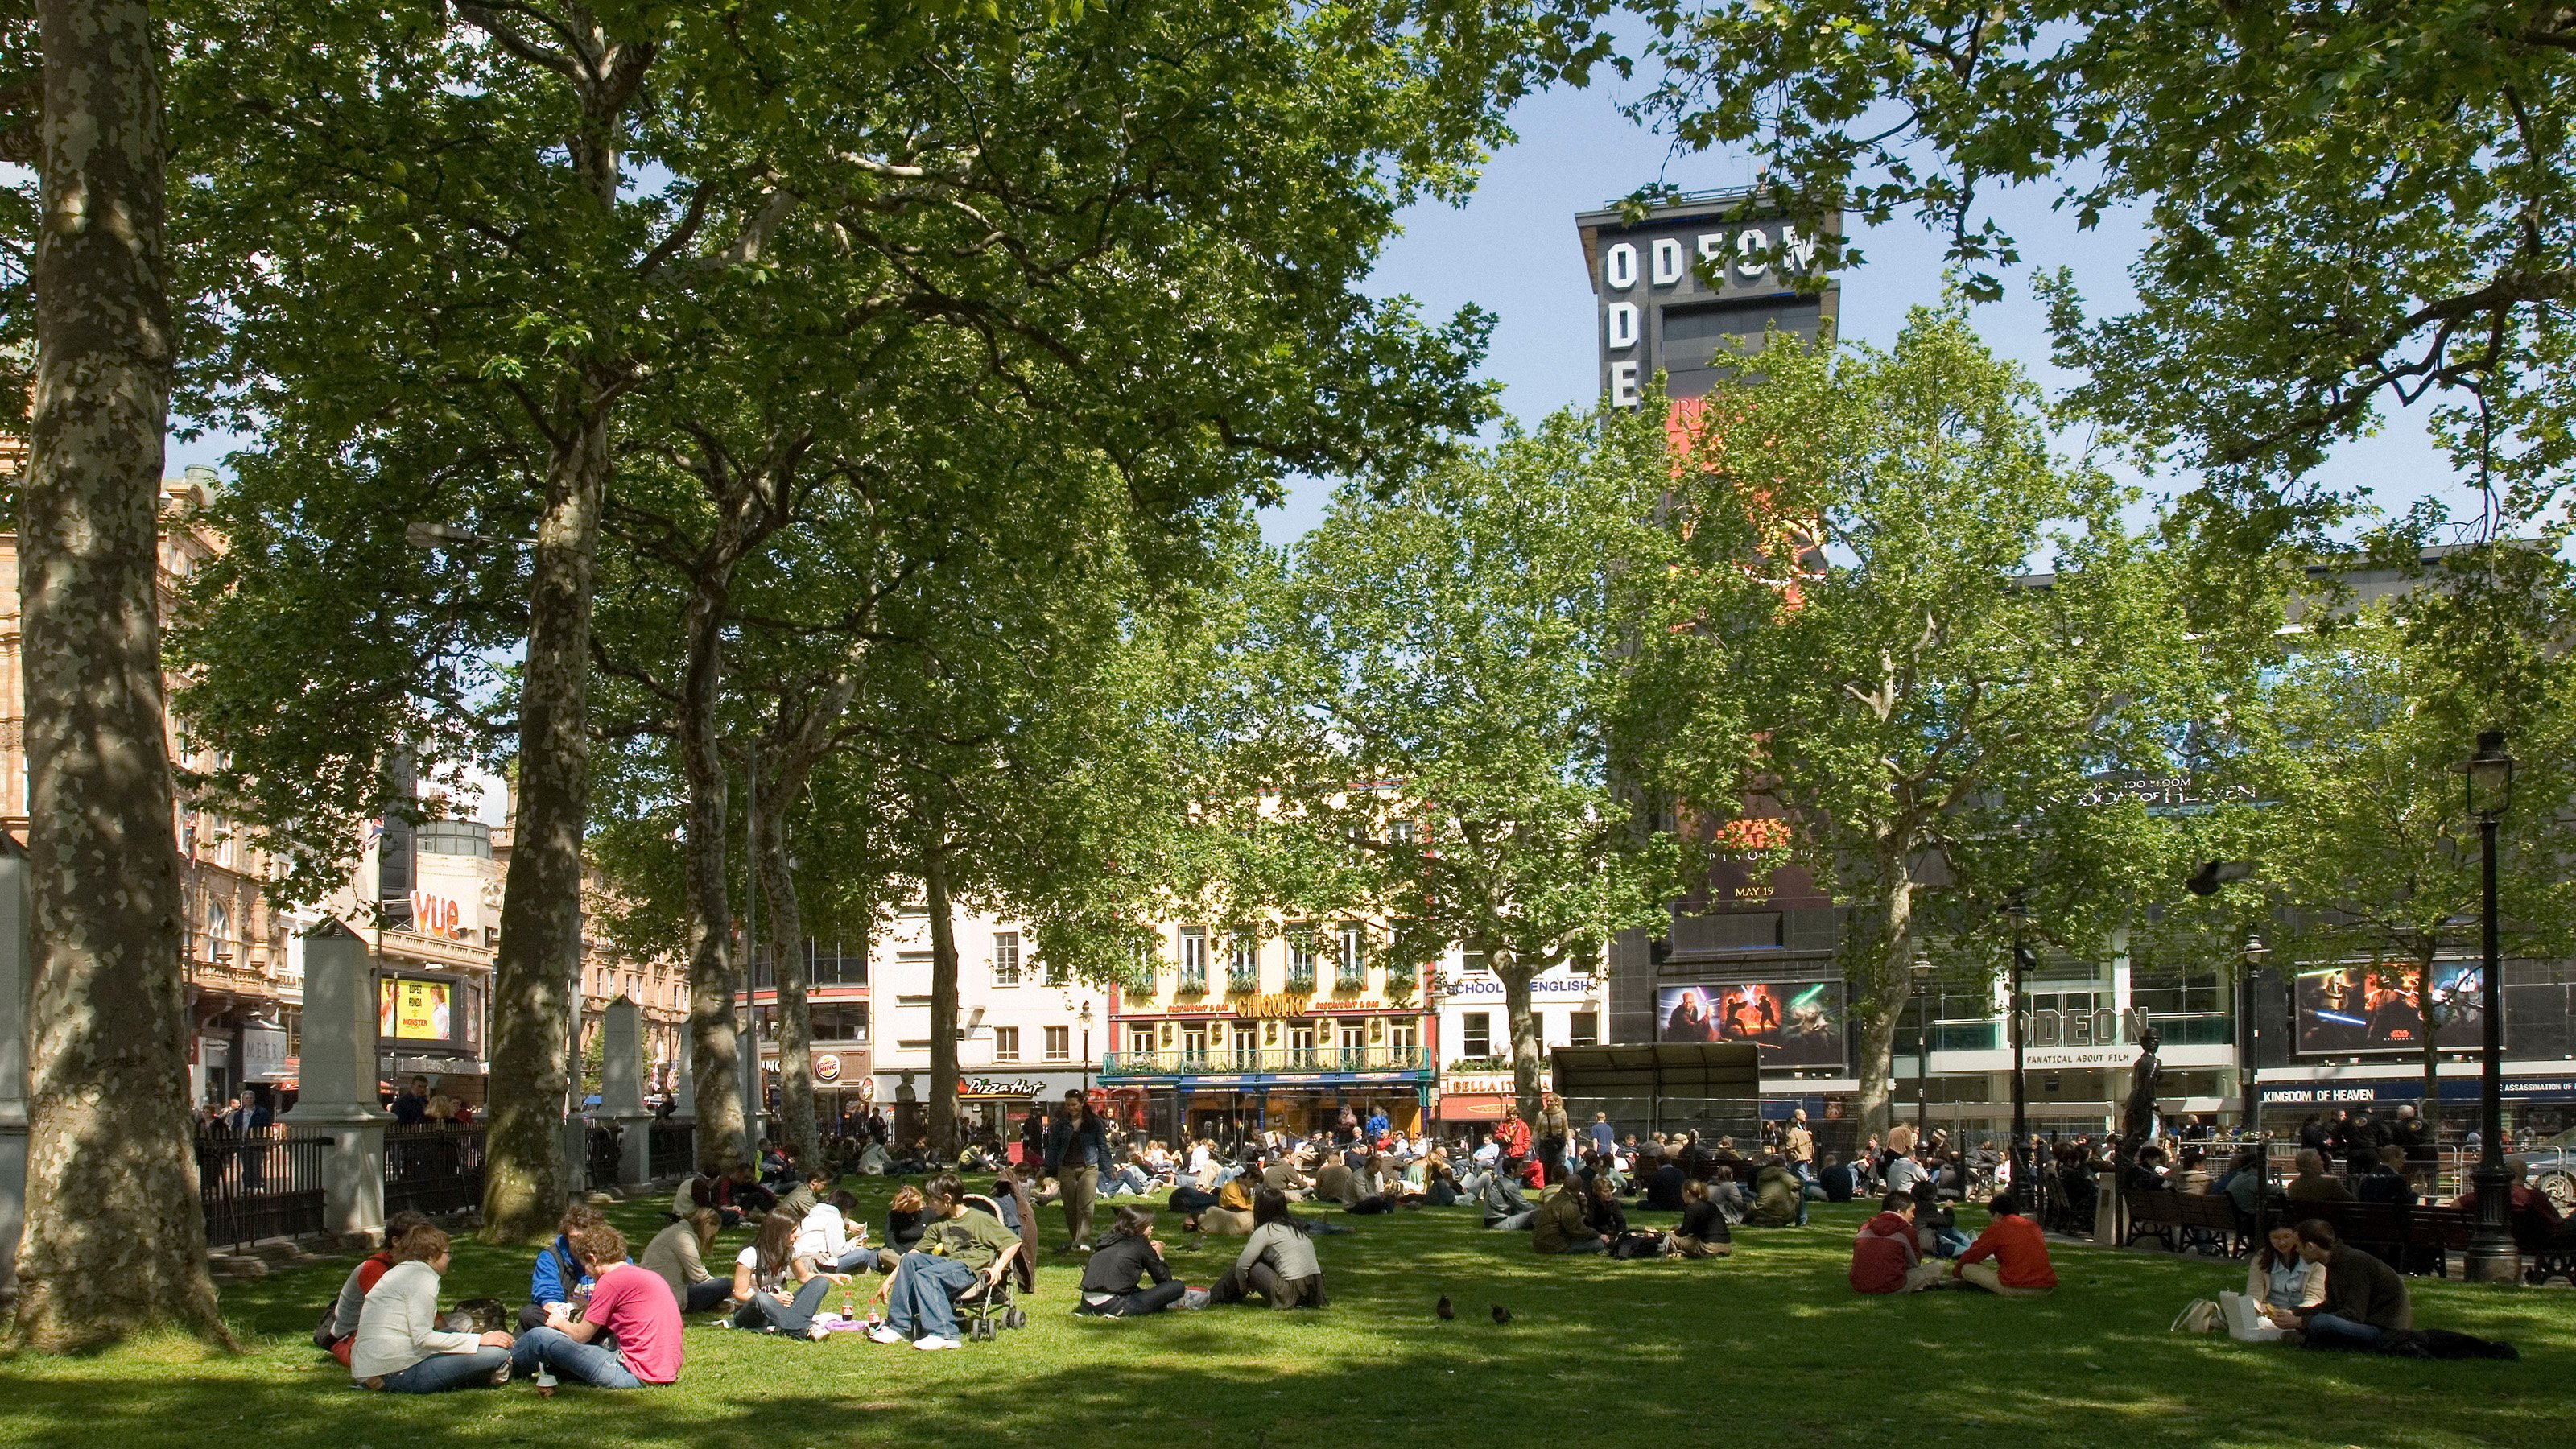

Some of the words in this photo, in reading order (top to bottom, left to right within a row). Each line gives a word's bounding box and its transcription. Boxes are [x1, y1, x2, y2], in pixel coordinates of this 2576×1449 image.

[2140, 792, 2160, 802] OF
[1735, 887, 1759, 897] MAY
[1763, 886, 1774, 896] 19
[1447, 983, 1504, 994] SCHOOL
[1530, 980, 1590, 992] ENGLISH
[1236, 994, 1307, 1018] CHIQUITO
[402, 1018, 427, 1026] MONSTER
[2007, 1007, 2148, 1047] ODEON
[2027, 1055, 2072, 1063] FANATICAL
[2076, 1055, 2103, 1063] ABOUT
[2108, 1054, 2129, 1062] FILM
[819, 1063, 837, 1073] KING
[967, 1079, 1009, 1095] Pizza
[1010, 1079, 1046, 1094] Hut
[1453, 1081, 1497, 1092] BELLA
[2504, 1083, 2561, 1092] ASSASSINATION
[2563, 1082, 2572, 1090] OF
[2264, 1090, 2312, 1102] KINGDOM
[2317, 1090, 2330, 1101] OF
[2333, 1088, 2374, 1101] HEAVEN
